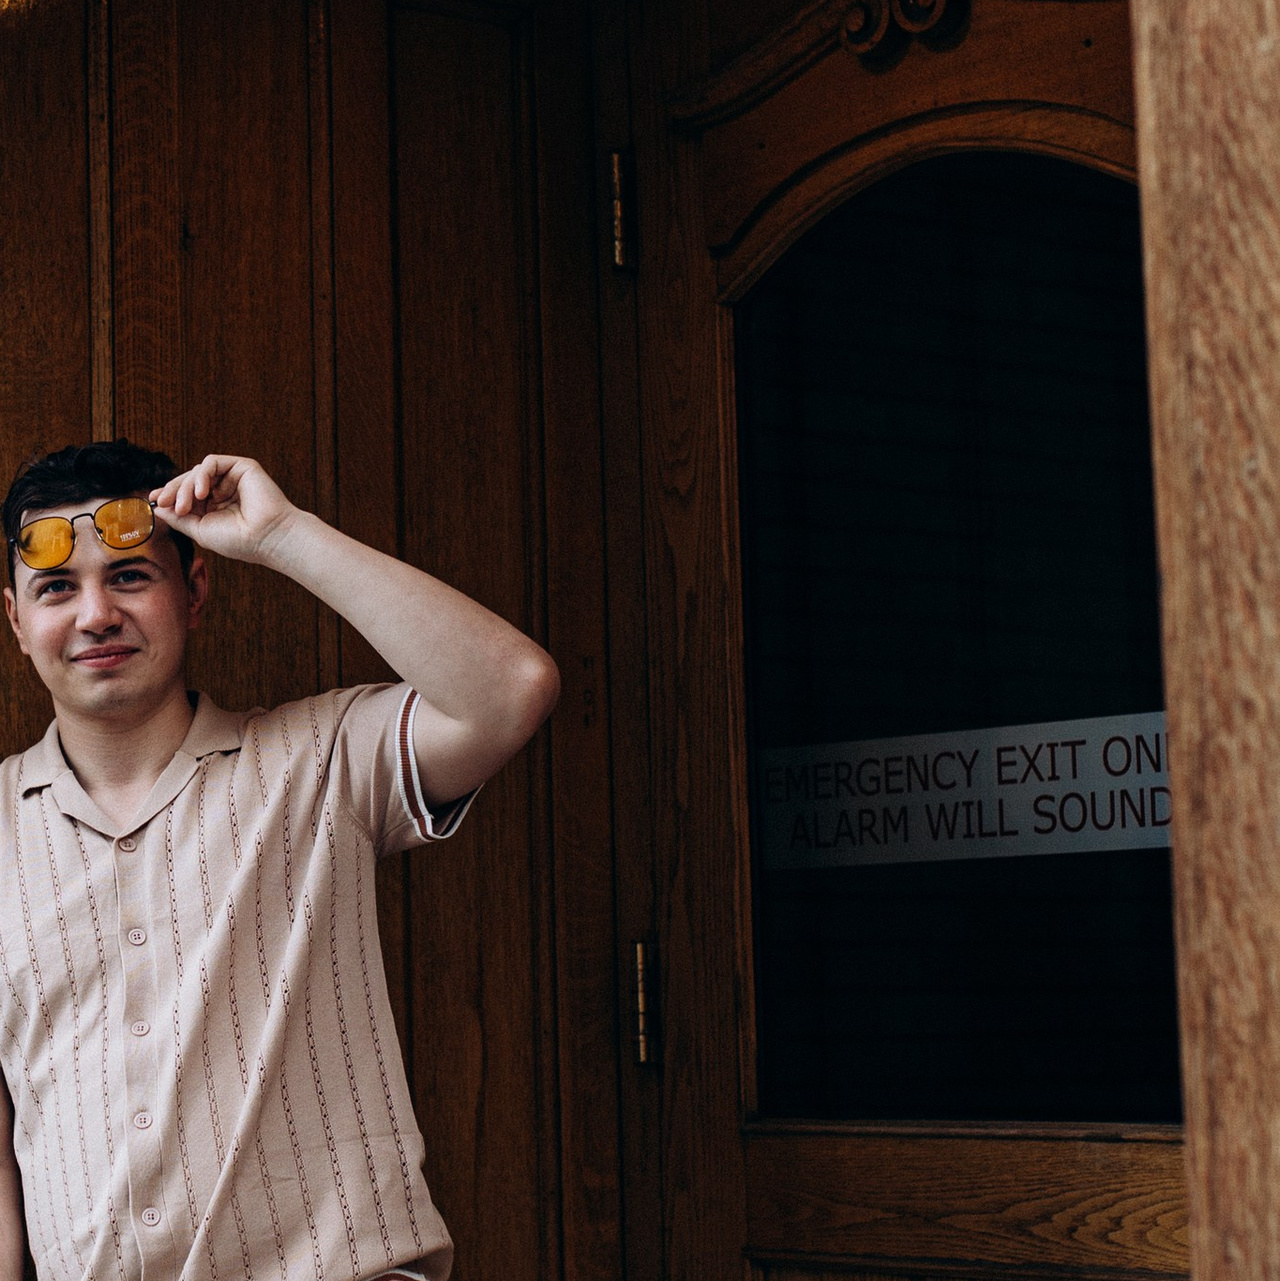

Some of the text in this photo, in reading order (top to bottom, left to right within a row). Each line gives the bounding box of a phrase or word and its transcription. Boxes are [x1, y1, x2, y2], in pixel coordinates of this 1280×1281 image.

[766, 732, 1170, 802] EMERGENCY EXIT ON
[790, 786, 1172, 849] ALARM WILL SOUND
